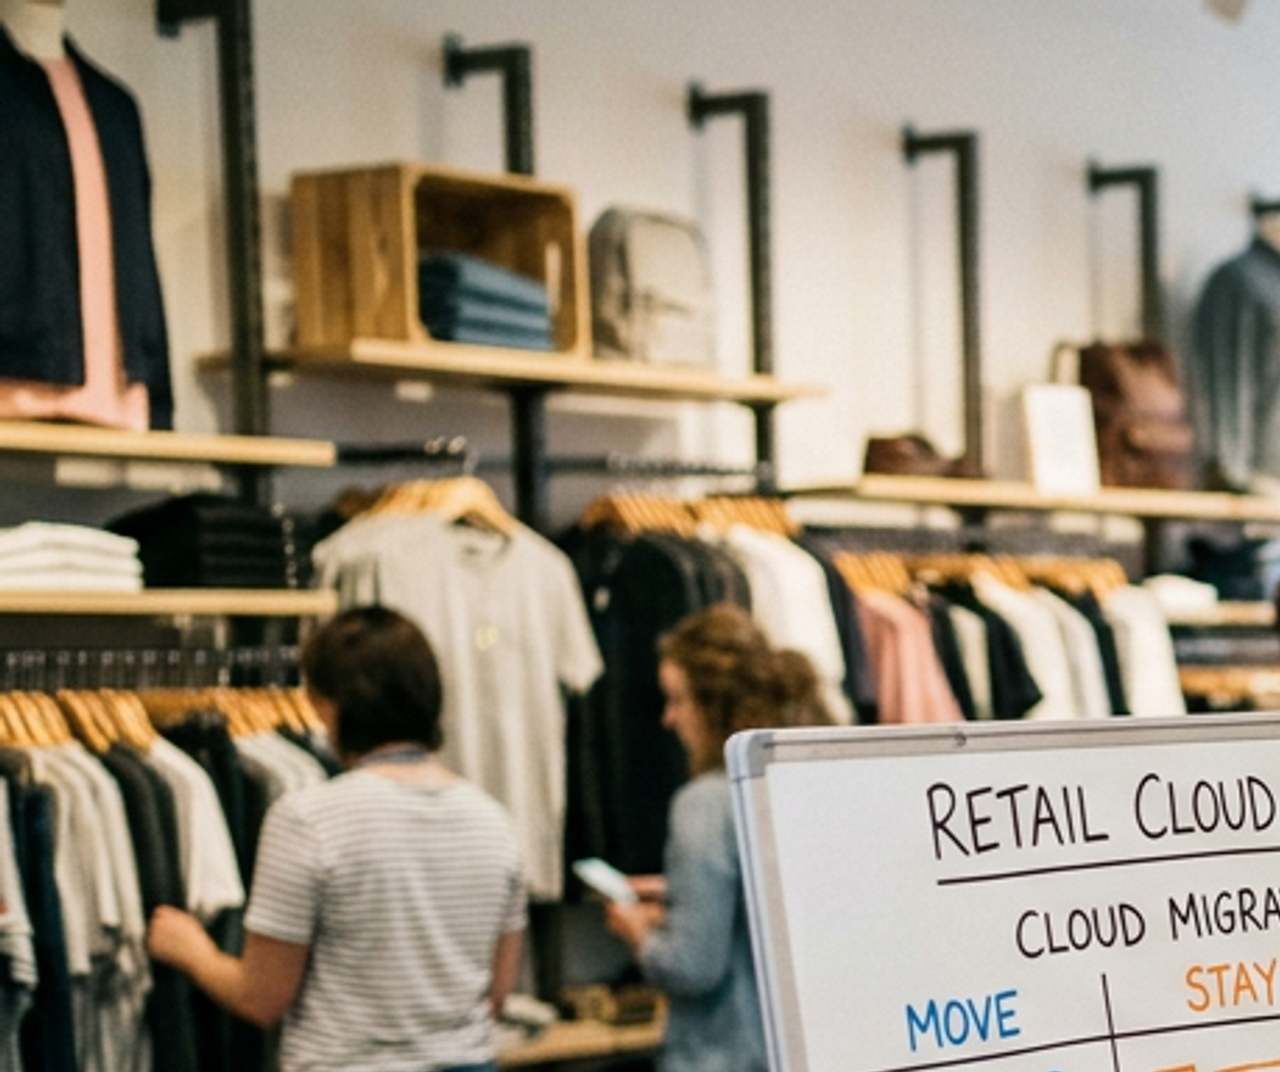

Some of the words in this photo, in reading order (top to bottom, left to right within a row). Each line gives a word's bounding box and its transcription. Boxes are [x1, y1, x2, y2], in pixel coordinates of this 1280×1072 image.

[926, 782, 1110, 861] RETAIL
[1134, 772, 1277, 840] CLOUD
[1015, 903, 1146, 959] CLOUD
[1184, 957, 1278, 1013] STAY
[905, 989, 1021, 1052] MOVE
